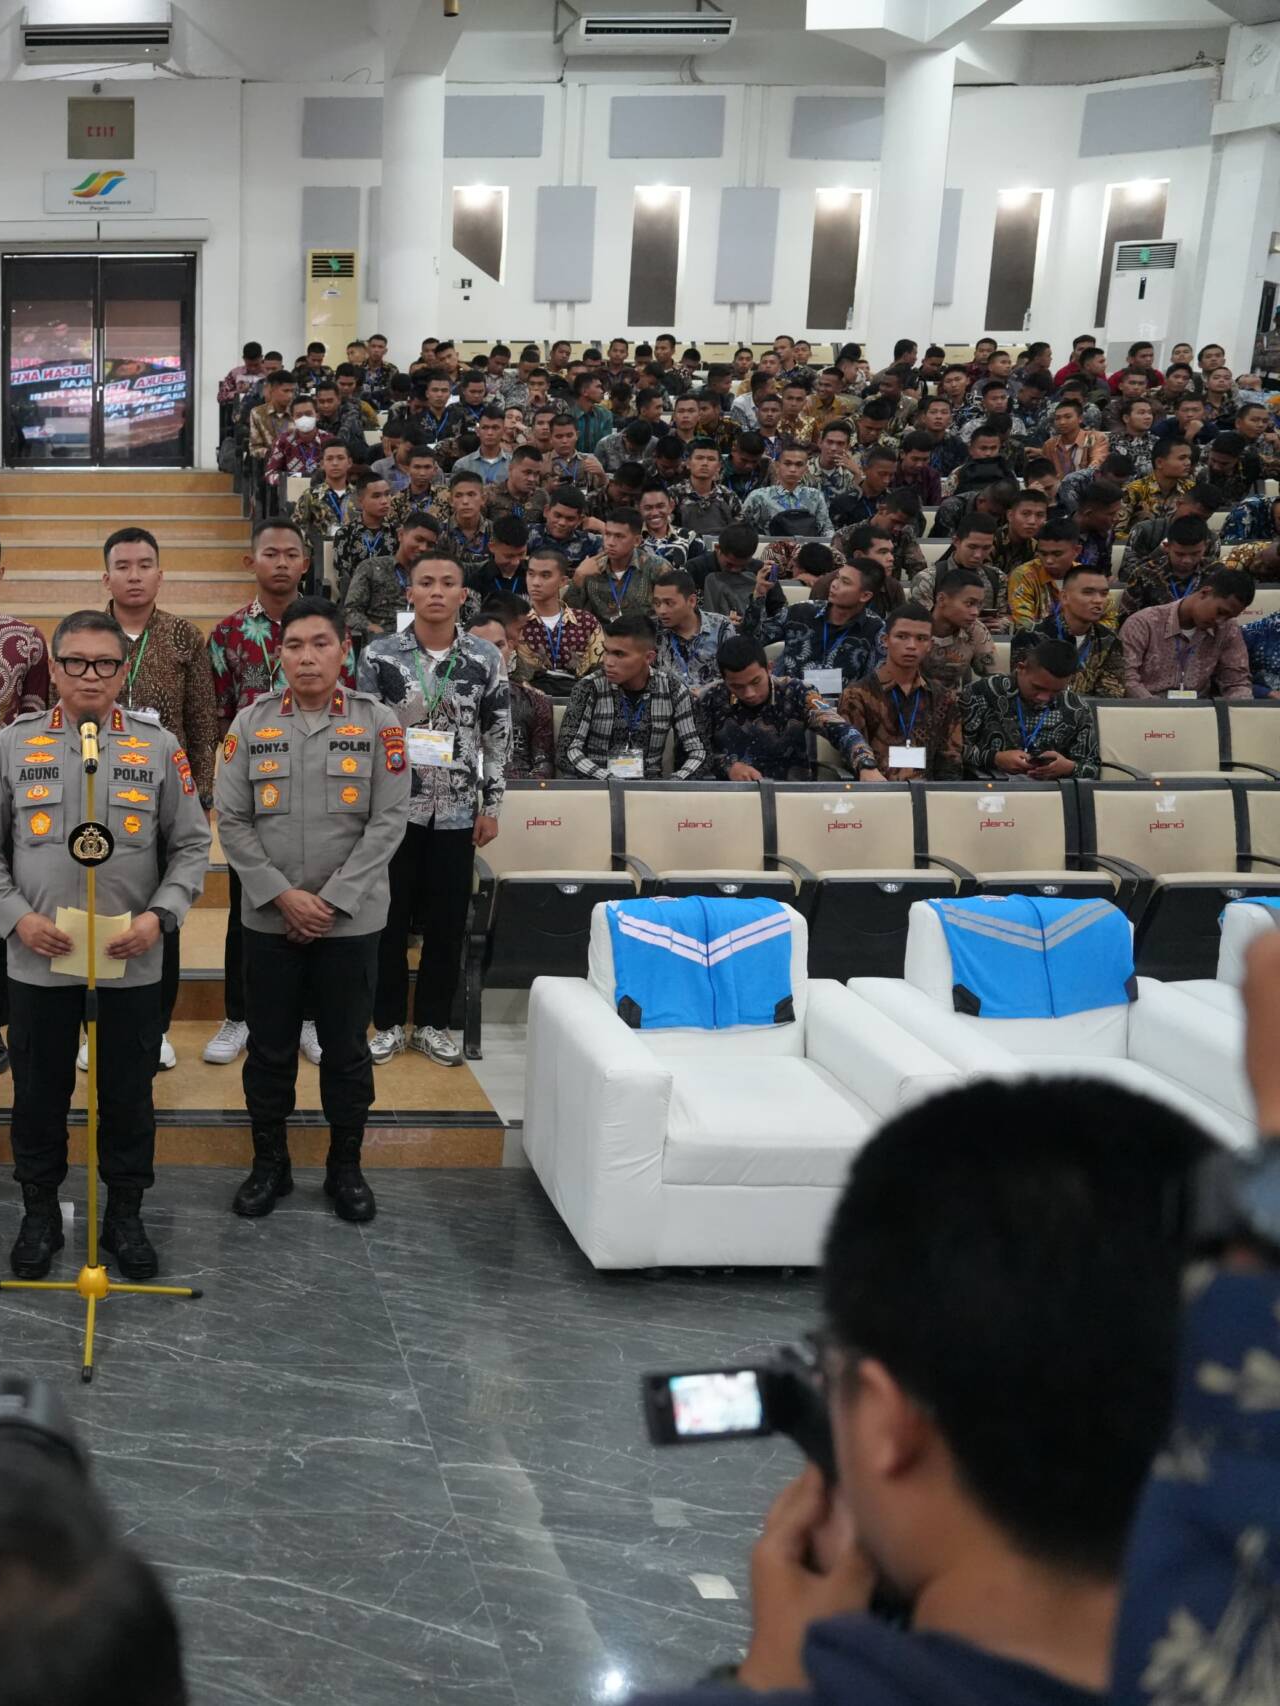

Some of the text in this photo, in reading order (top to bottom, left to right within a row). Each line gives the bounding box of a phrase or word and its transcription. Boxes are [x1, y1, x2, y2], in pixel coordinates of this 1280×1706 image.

[250, 742, 290, 755] RONY.S
[329, 741, 370, 752] POLRI
[19, 767, 60, 781] AGUNG
[113, 767, 154, 783] POLRI
